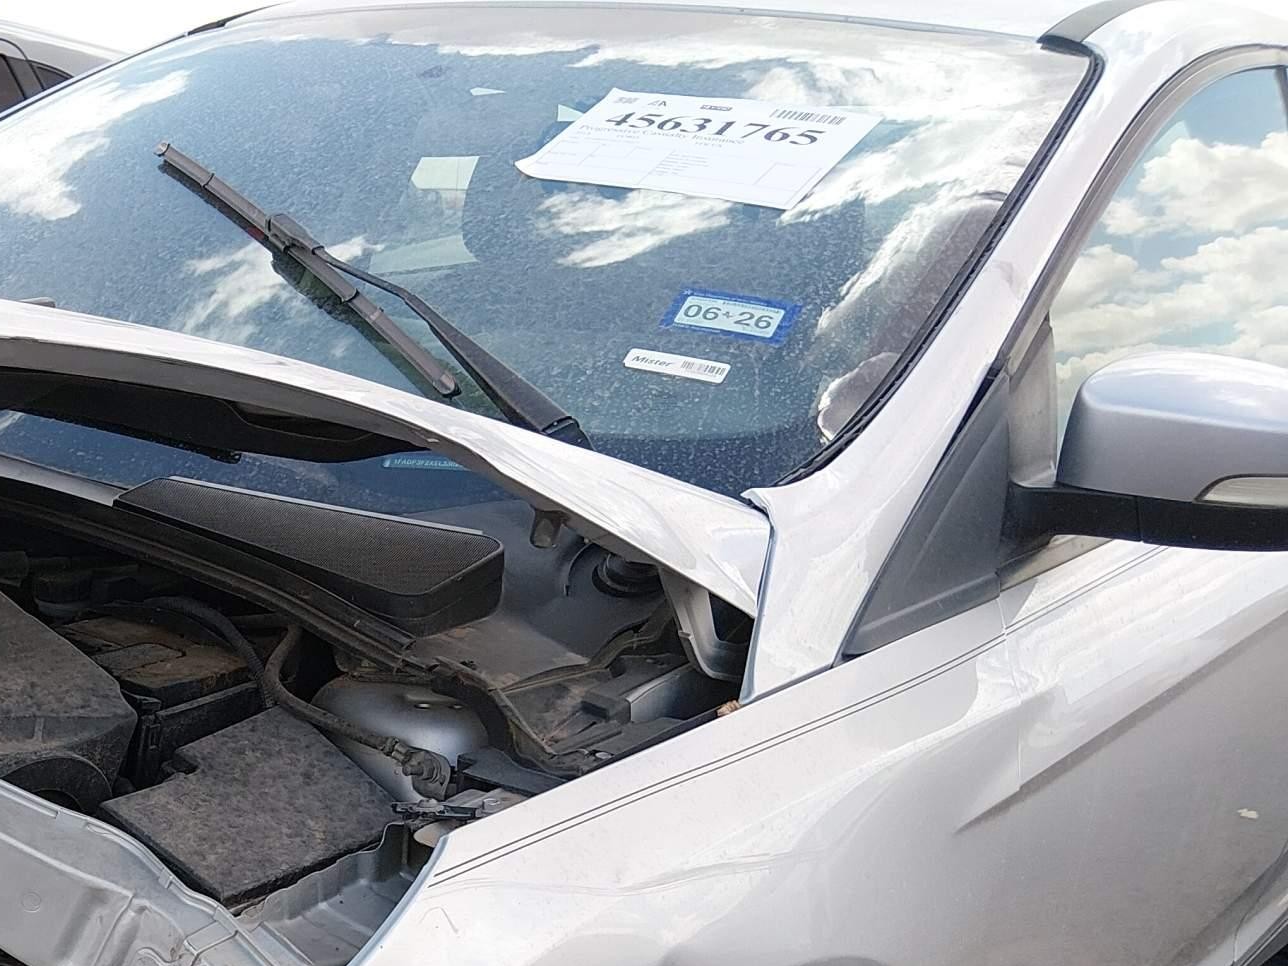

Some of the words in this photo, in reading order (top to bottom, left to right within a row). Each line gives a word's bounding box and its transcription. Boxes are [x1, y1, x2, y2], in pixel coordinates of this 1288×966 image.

[605, 112, 828, 146] 45631765
[683, 304, 722, 321] 06
[733, 311, 774, 330] 26
[631, 355, 673, 367] Mister
